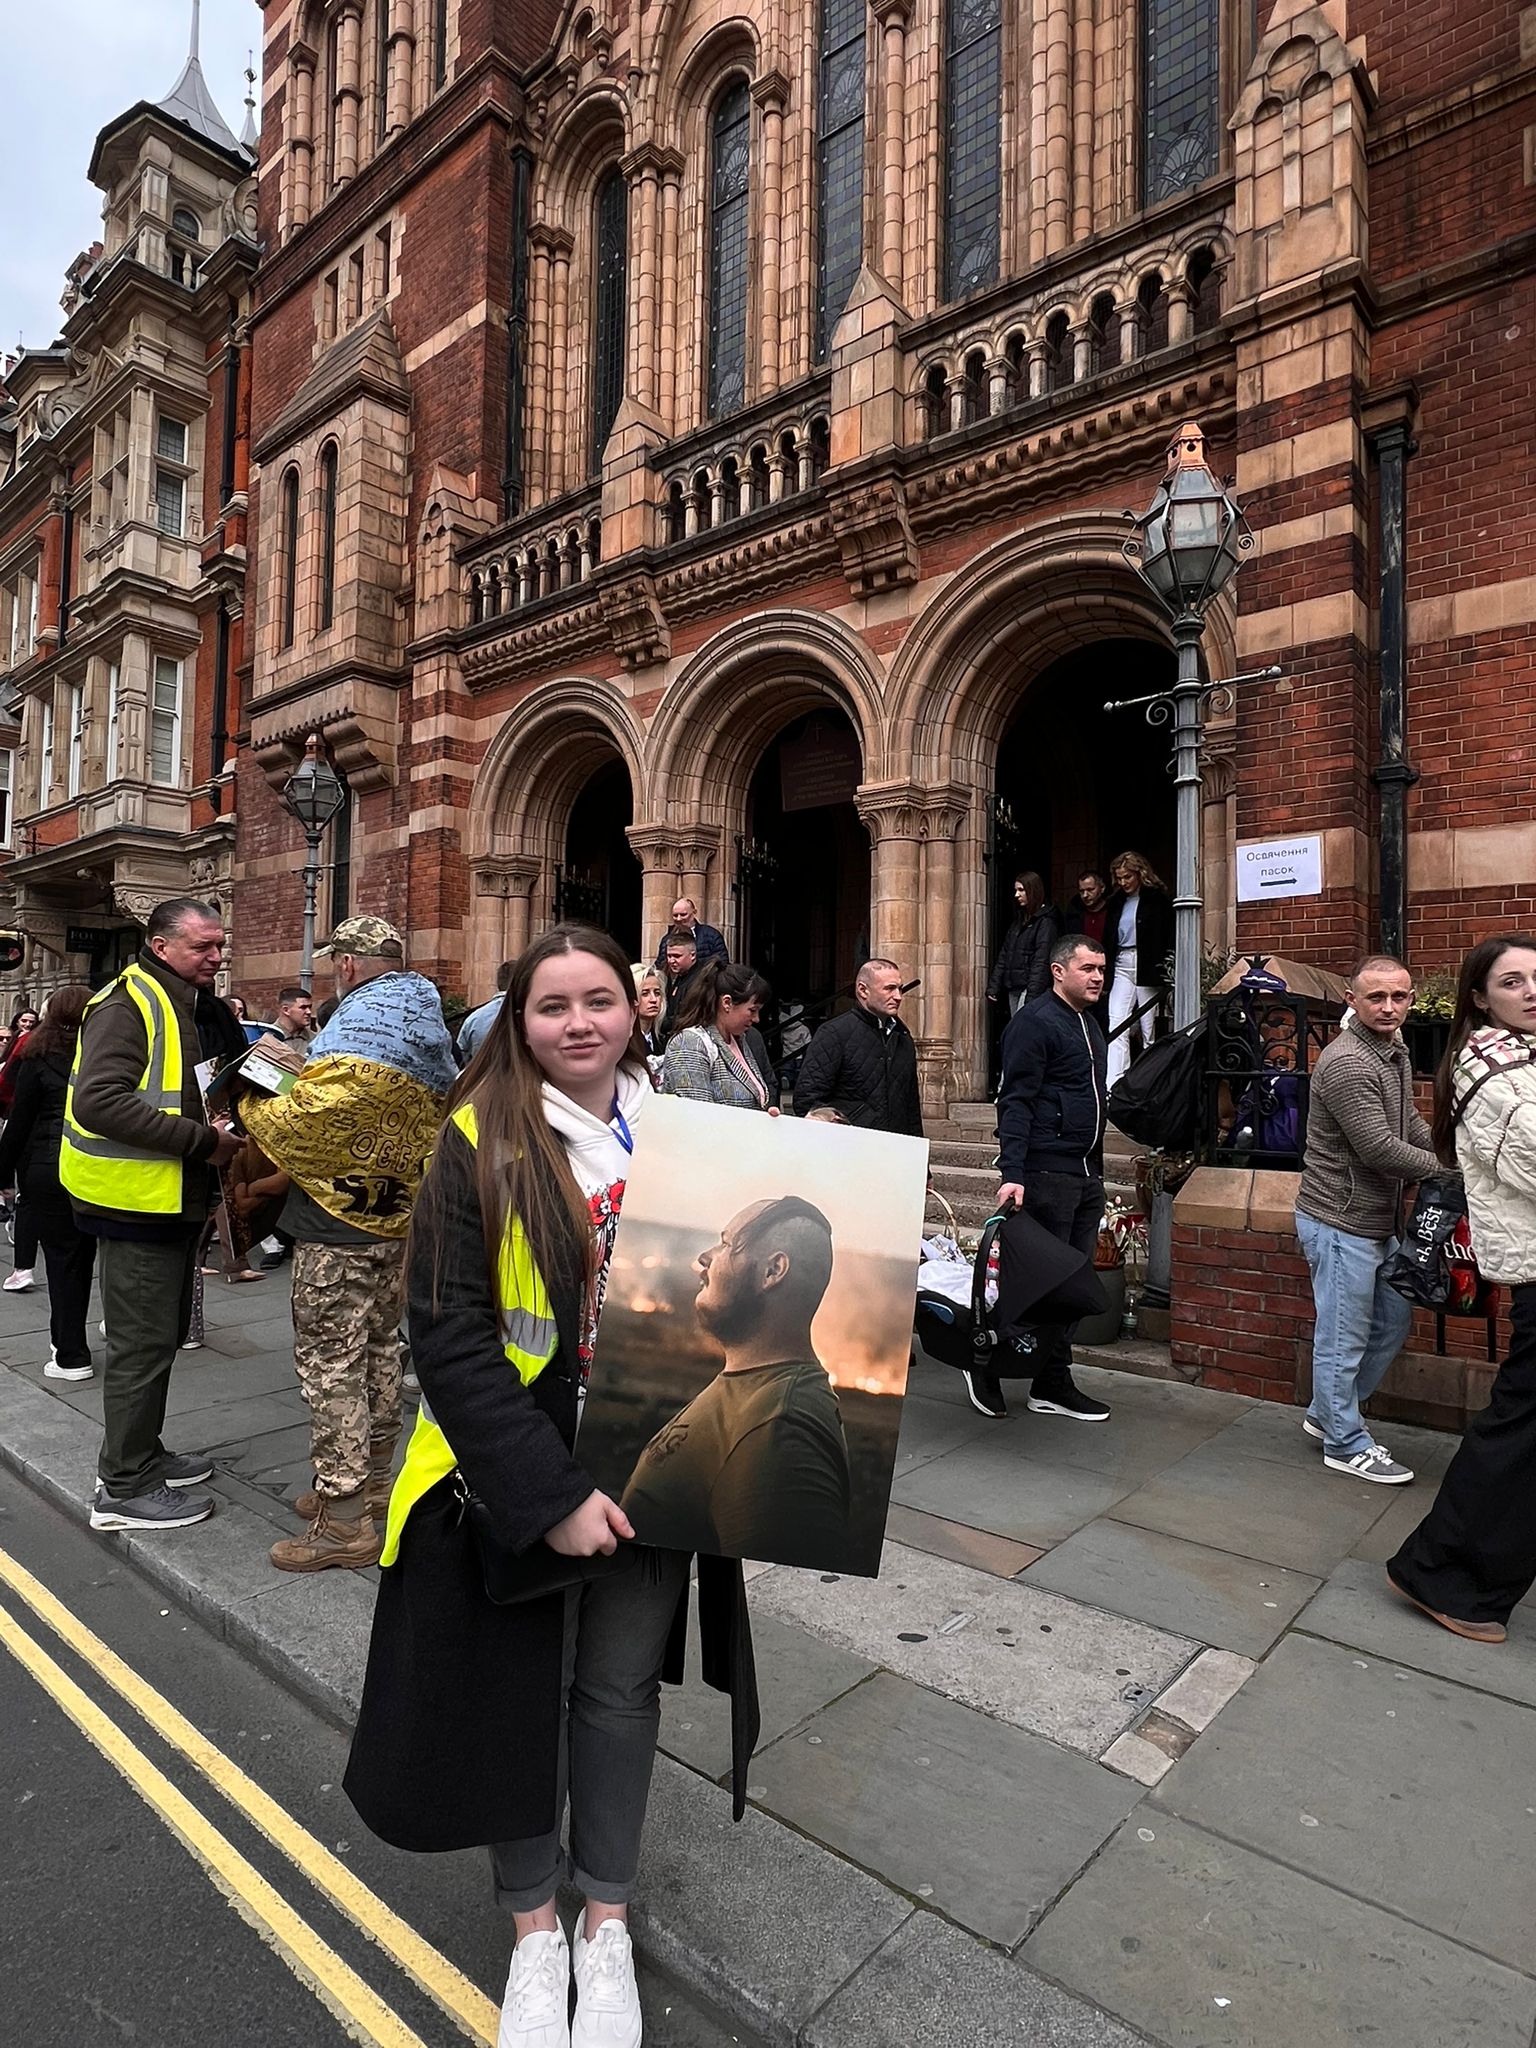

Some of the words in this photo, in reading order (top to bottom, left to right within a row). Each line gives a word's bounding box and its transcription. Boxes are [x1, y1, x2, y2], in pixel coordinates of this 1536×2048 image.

[1246, 847, 1308, 862] Освячення
[1260, 866, 1295, 877] пасок
[1417, 1205, 1443, 1242] Best
[1416, 1243, 1433, 1263] th
